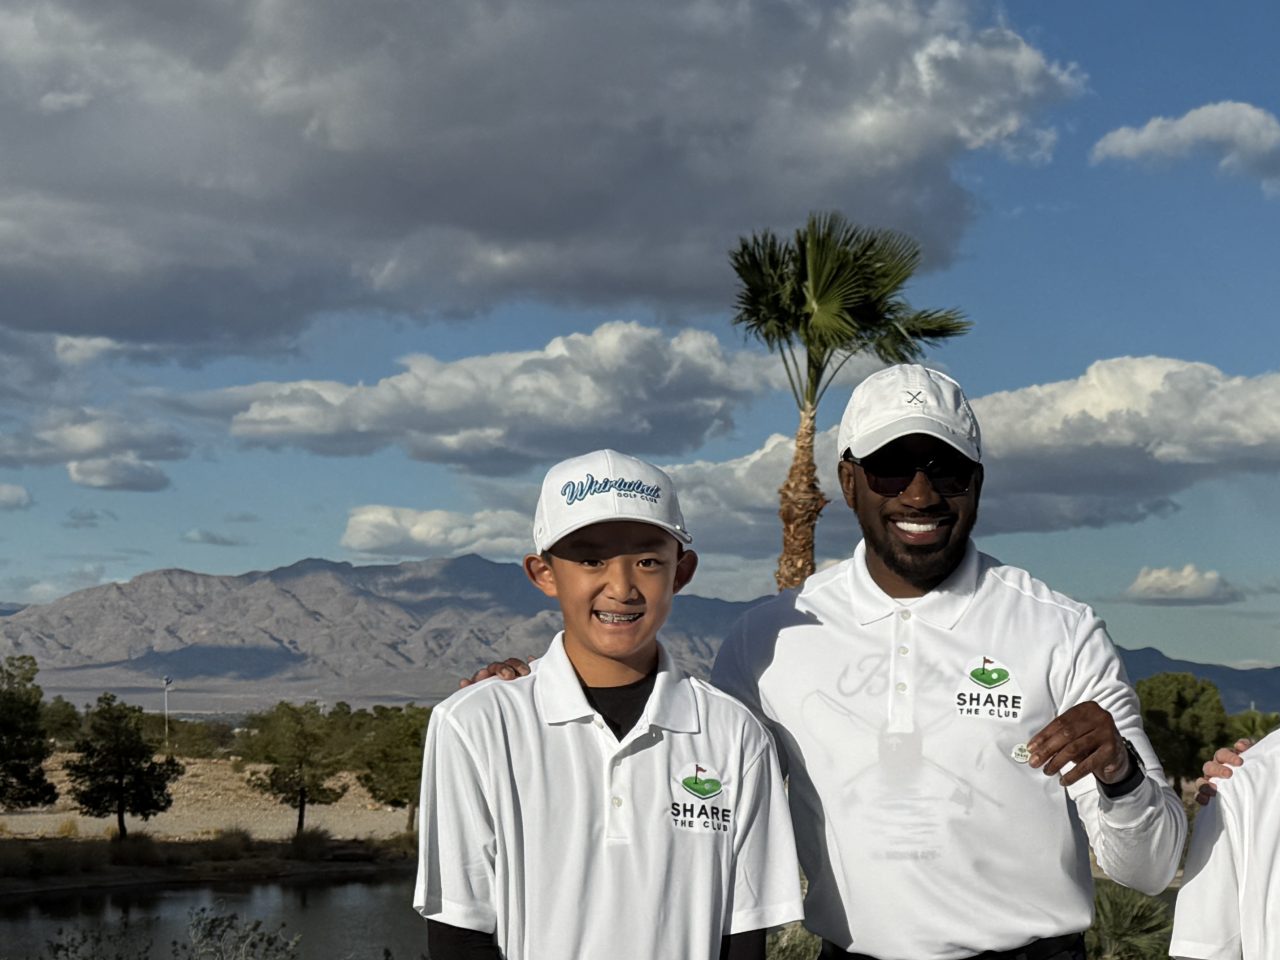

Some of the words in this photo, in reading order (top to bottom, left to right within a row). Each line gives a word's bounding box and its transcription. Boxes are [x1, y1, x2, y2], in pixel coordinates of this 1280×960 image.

[561, 473, 662, 505] Whirlwind
[617, 491, 637, 499] GOLF
[640, 494, 658, 504] CLUB
[956, 692, 1022, 709] SHARE
[958, 707, 979, 716] THE
[989, 708, 1019, 719] CLUB
[671, 802, 732, 823] SHARE
[673, 818, 694, 828] THE
[702, 820, 729, 832] CLUB
